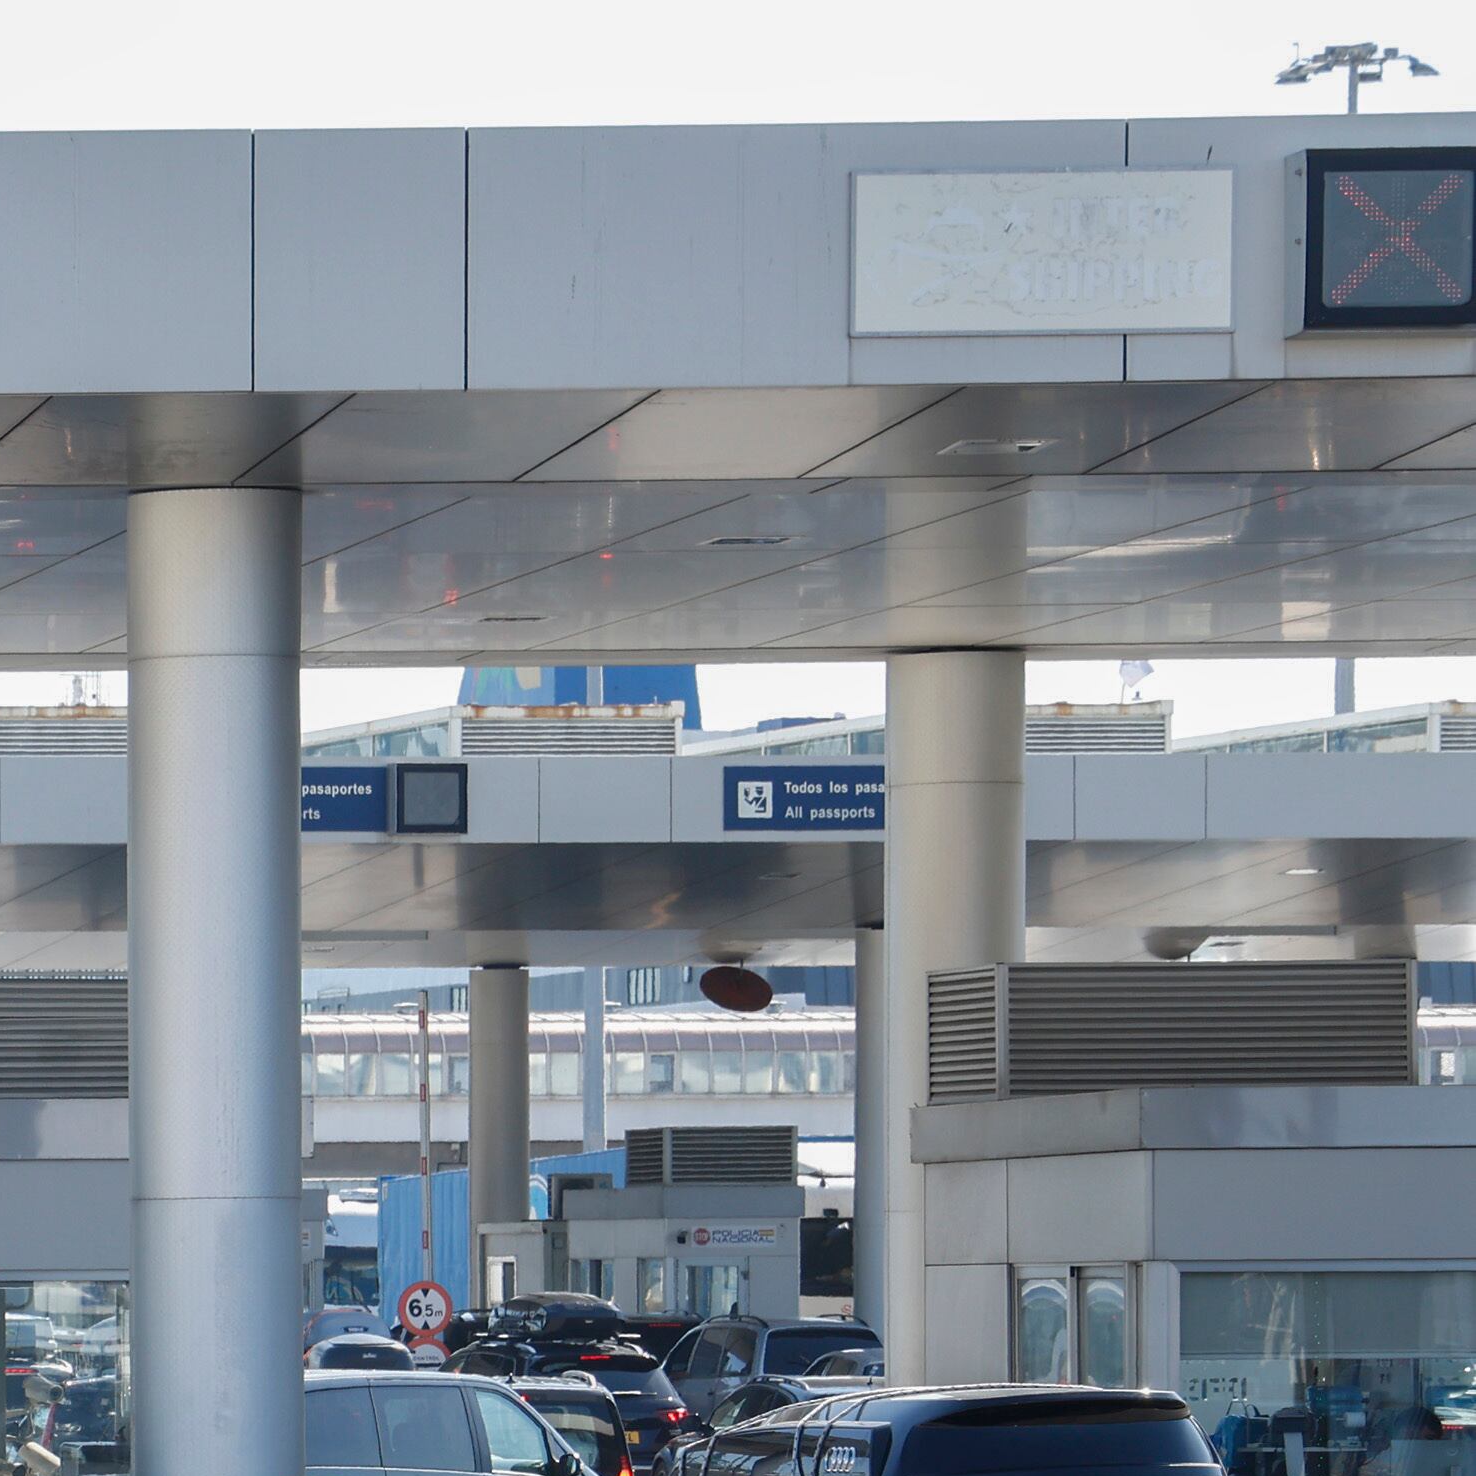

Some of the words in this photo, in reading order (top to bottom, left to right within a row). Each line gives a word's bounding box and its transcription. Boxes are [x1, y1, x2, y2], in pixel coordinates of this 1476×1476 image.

[302, 783, 373, 798] pasaportes
[784, 781, 823, 794] Todos
[829, 781, 849, 794] los
[785, 806, 803, 819] All
[810, 806, 876, 821] passports
